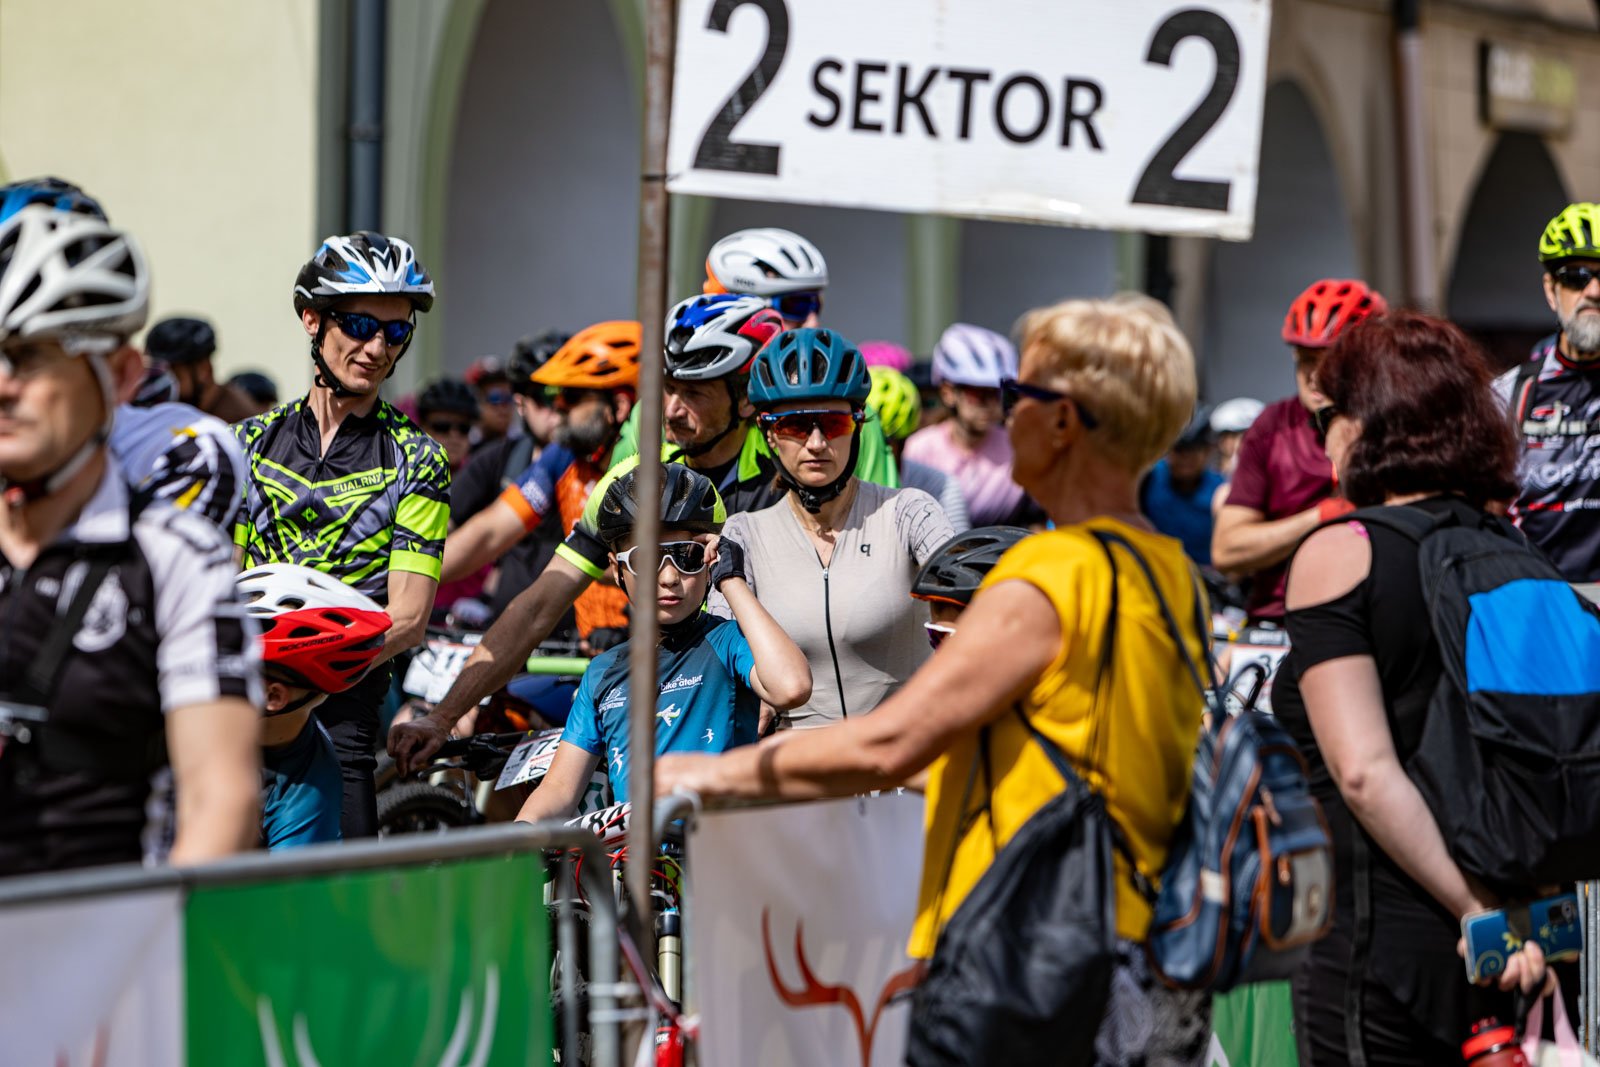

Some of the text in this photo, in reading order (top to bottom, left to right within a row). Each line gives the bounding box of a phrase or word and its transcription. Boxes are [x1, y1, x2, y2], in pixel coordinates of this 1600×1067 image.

[692, 0, 1243, 212] 2 SEKTOR 2
[660, 674, 703, 691] bike atelier
